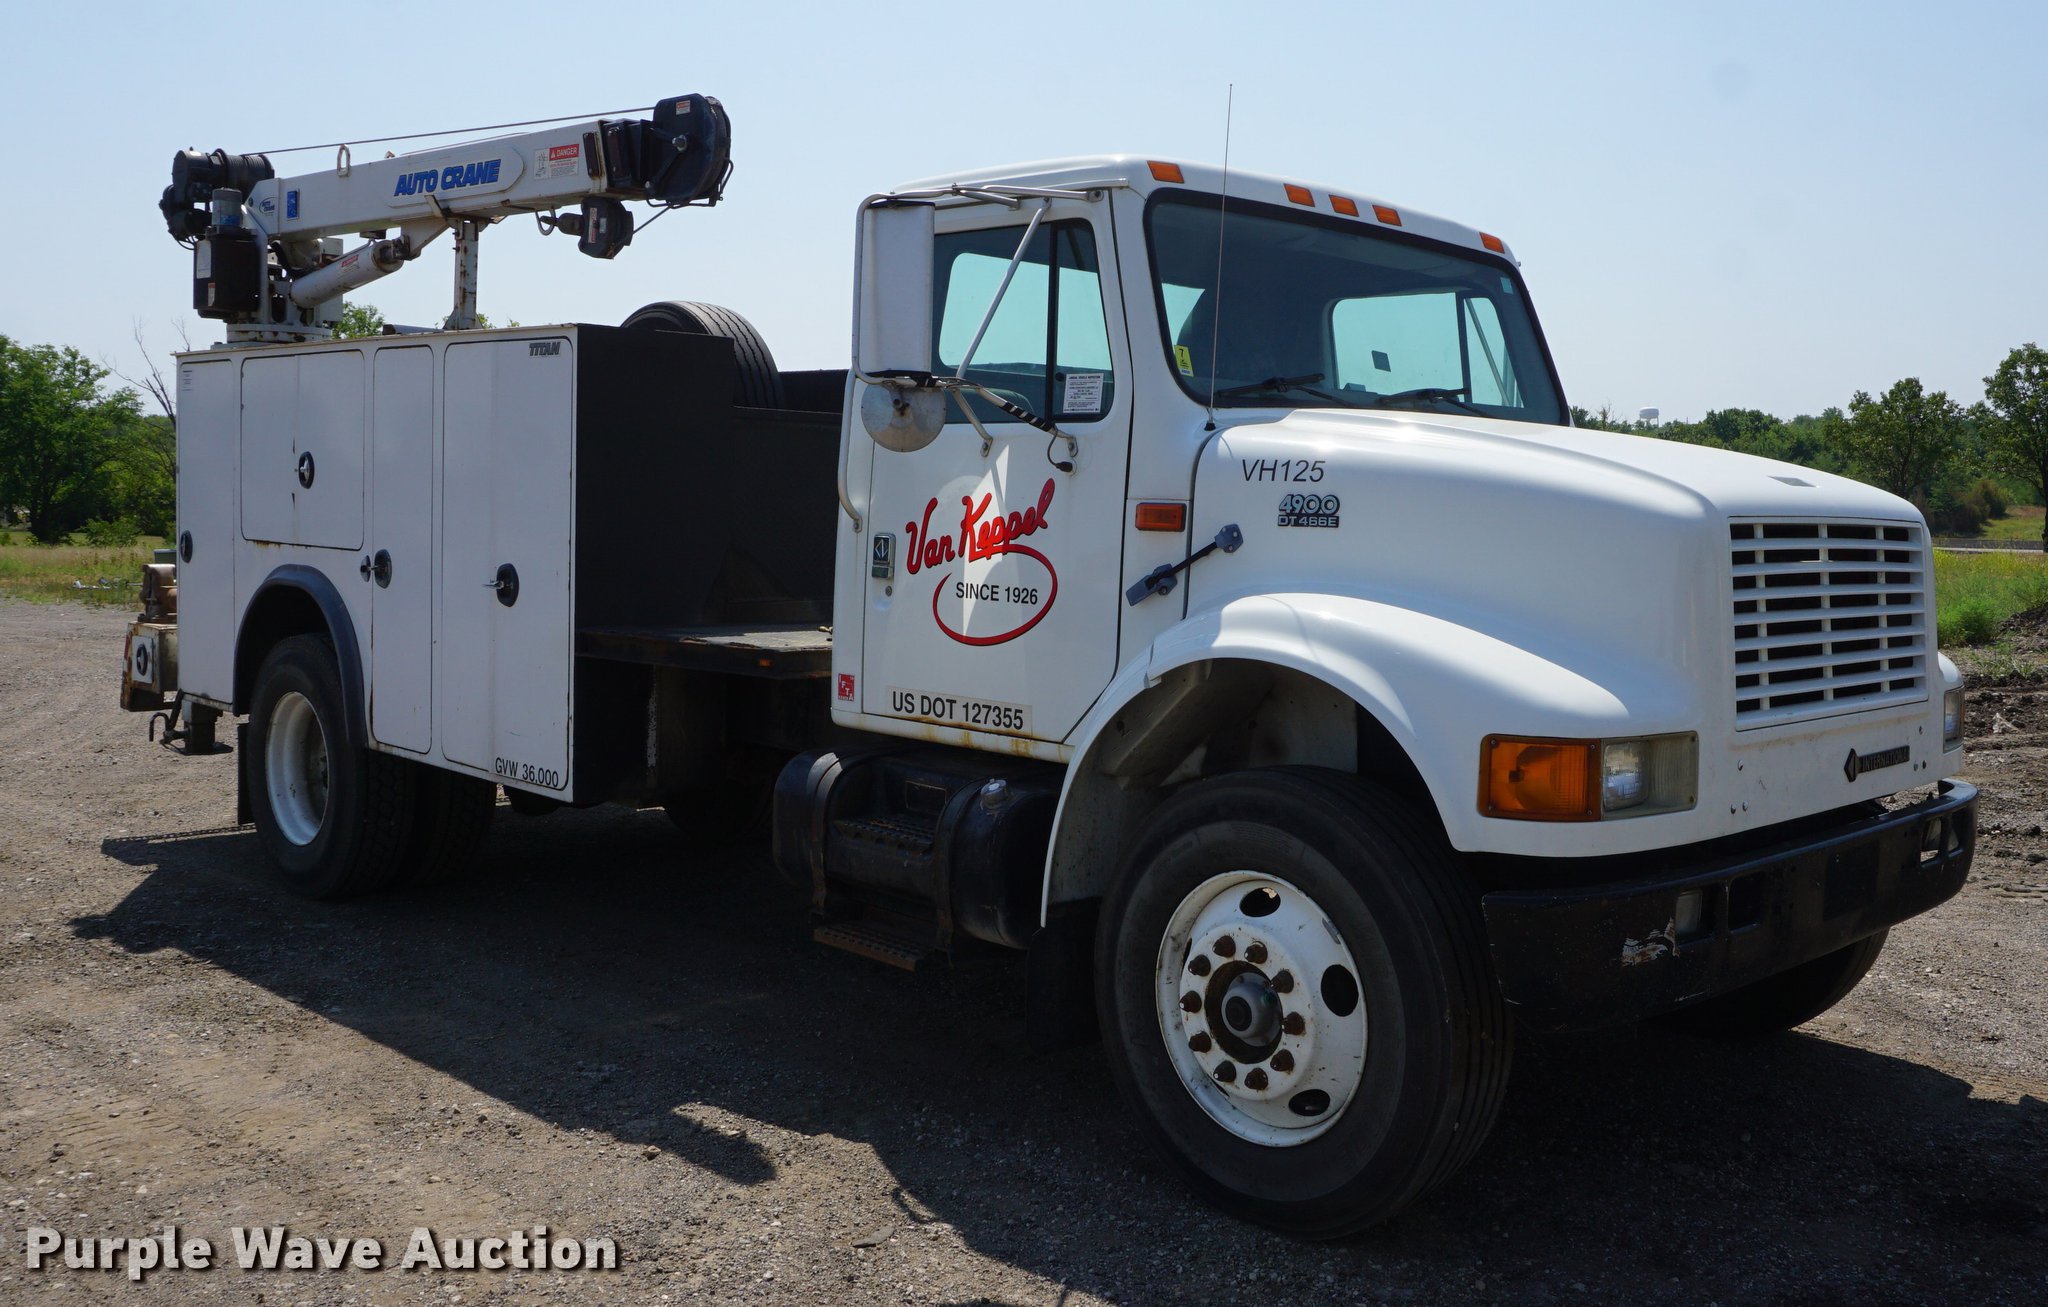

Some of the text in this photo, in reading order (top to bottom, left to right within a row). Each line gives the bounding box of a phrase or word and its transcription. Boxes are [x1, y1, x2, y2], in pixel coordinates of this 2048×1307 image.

[394, 159, 502, 196] AUTO CRANE
[529, 341, 561, 356] TITAN
[1242, 459, 1326, 482] VH125
[1278, 494, 1340, 516] 4900
[905, 478, 1056, 575] Van Keppel
[1279, 515, 1338, 527] DT 466E
[956, 582, 1038, 605] SINCE 1926
[892, 690, 1024, 730] US DOT 127355
[495, 757, 518, 777] GVW
